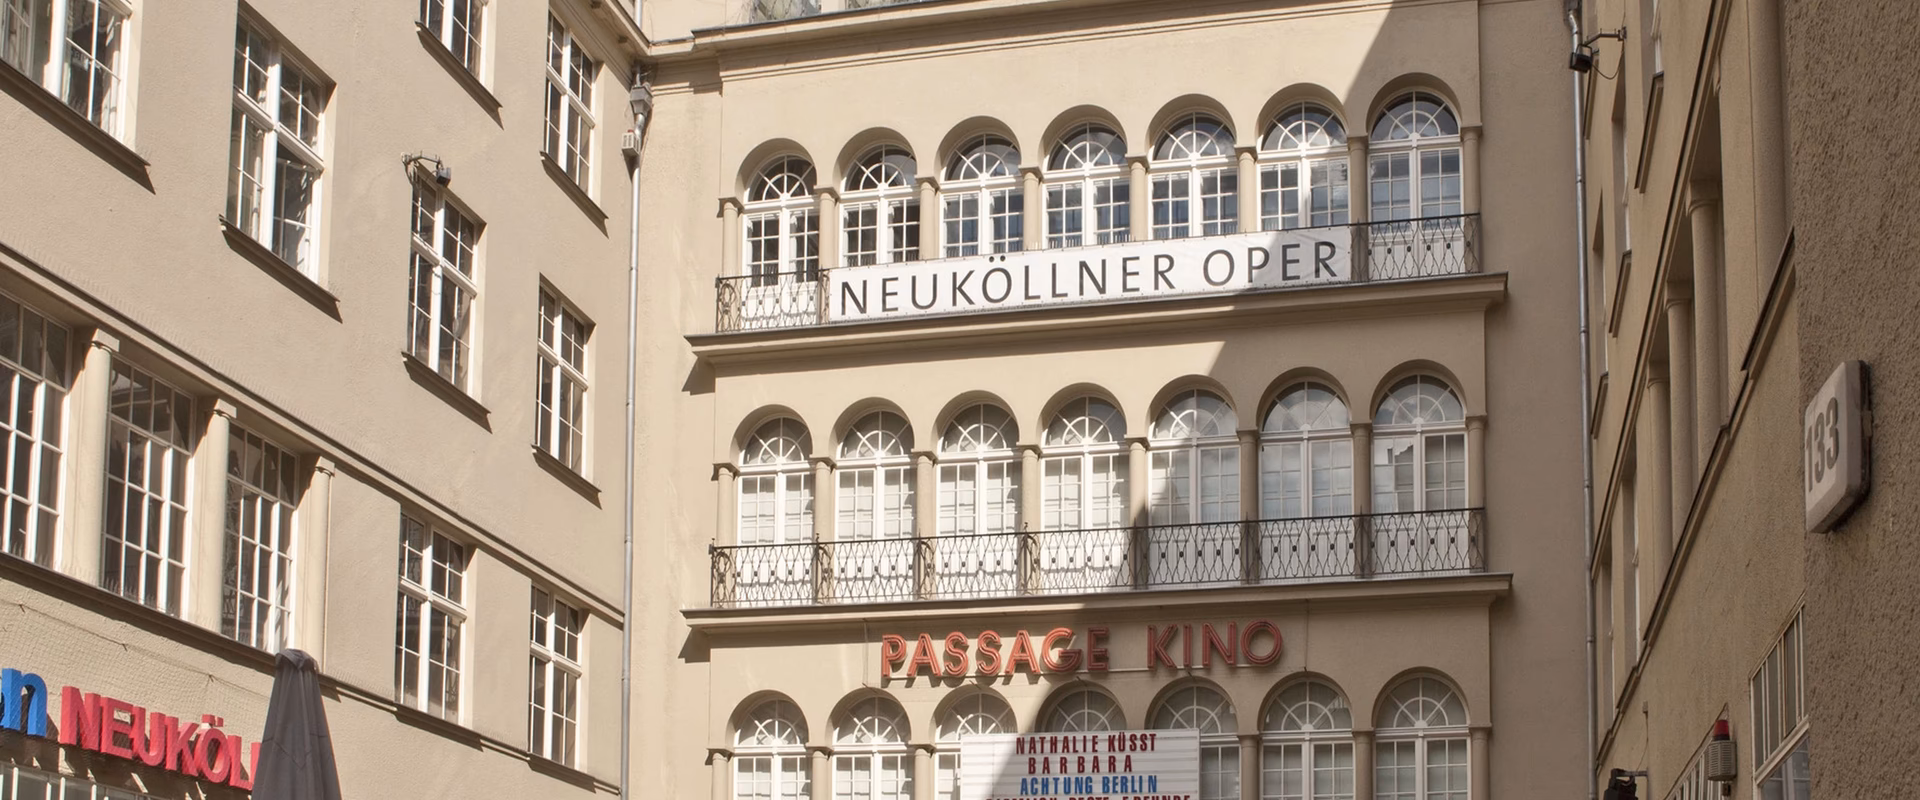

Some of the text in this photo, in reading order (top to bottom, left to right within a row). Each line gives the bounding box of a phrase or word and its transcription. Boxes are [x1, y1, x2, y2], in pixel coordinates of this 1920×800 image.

[840, 240, 1338, 316] NEUKÖLLNER OPER
[1806, 396, 1840, 493] 133
[880, 618, 1284, 679] PASSAGE KINO
[1015, 732, 1157, 755] NATHALIE KÜSST
[1020, 775, 1158, 796] ACHTUNG BERLIN
[1028, 755, 1133, 775] BARBARA
